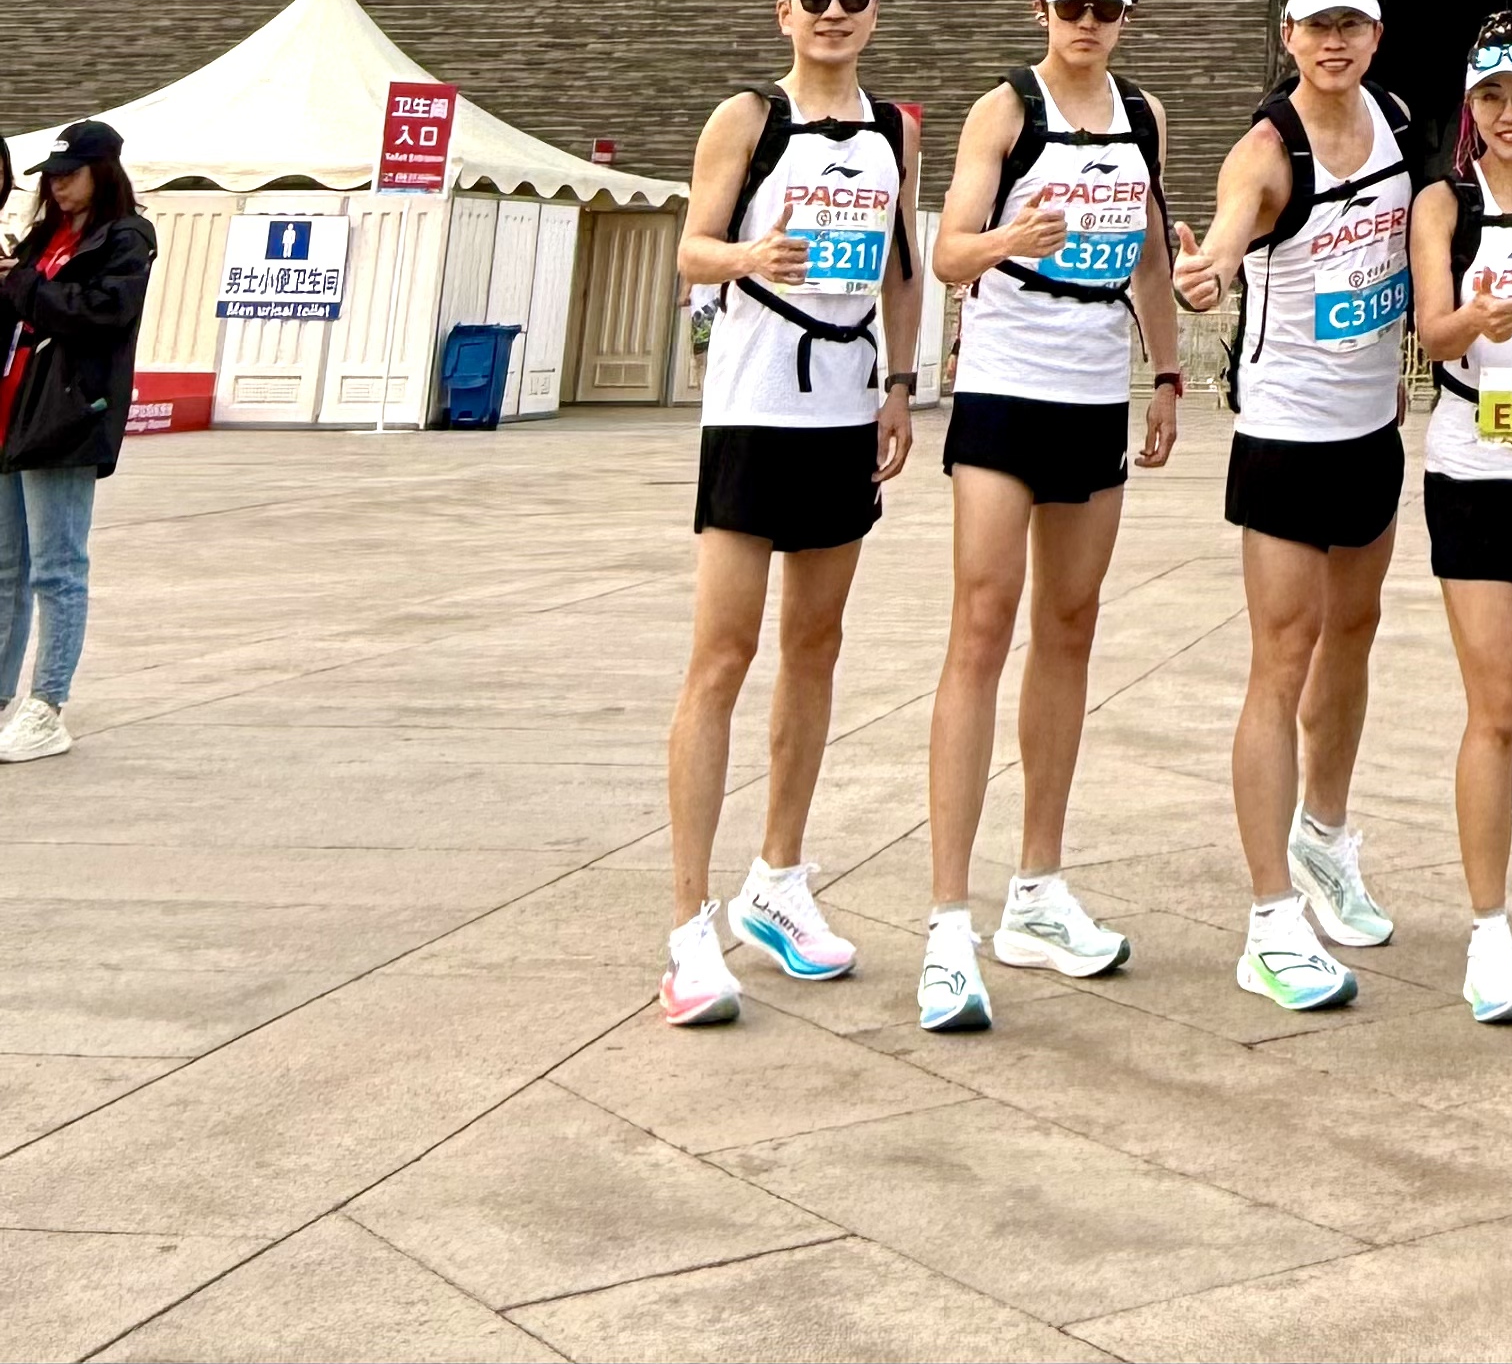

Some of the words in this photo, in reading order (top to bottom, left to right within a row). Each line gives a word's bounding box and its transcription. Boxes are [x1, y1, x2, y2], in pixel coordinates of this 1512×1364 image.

[394, 124, 439, 147] 入口
[783, 185, 890, 211] PACER
[1040, 181, 1146, 205] PACER
[1311, 207, 1406, 256] PACER
[1054, 241, 1139, 270] C3219
[1328, 282, 1406, 329] C3199
